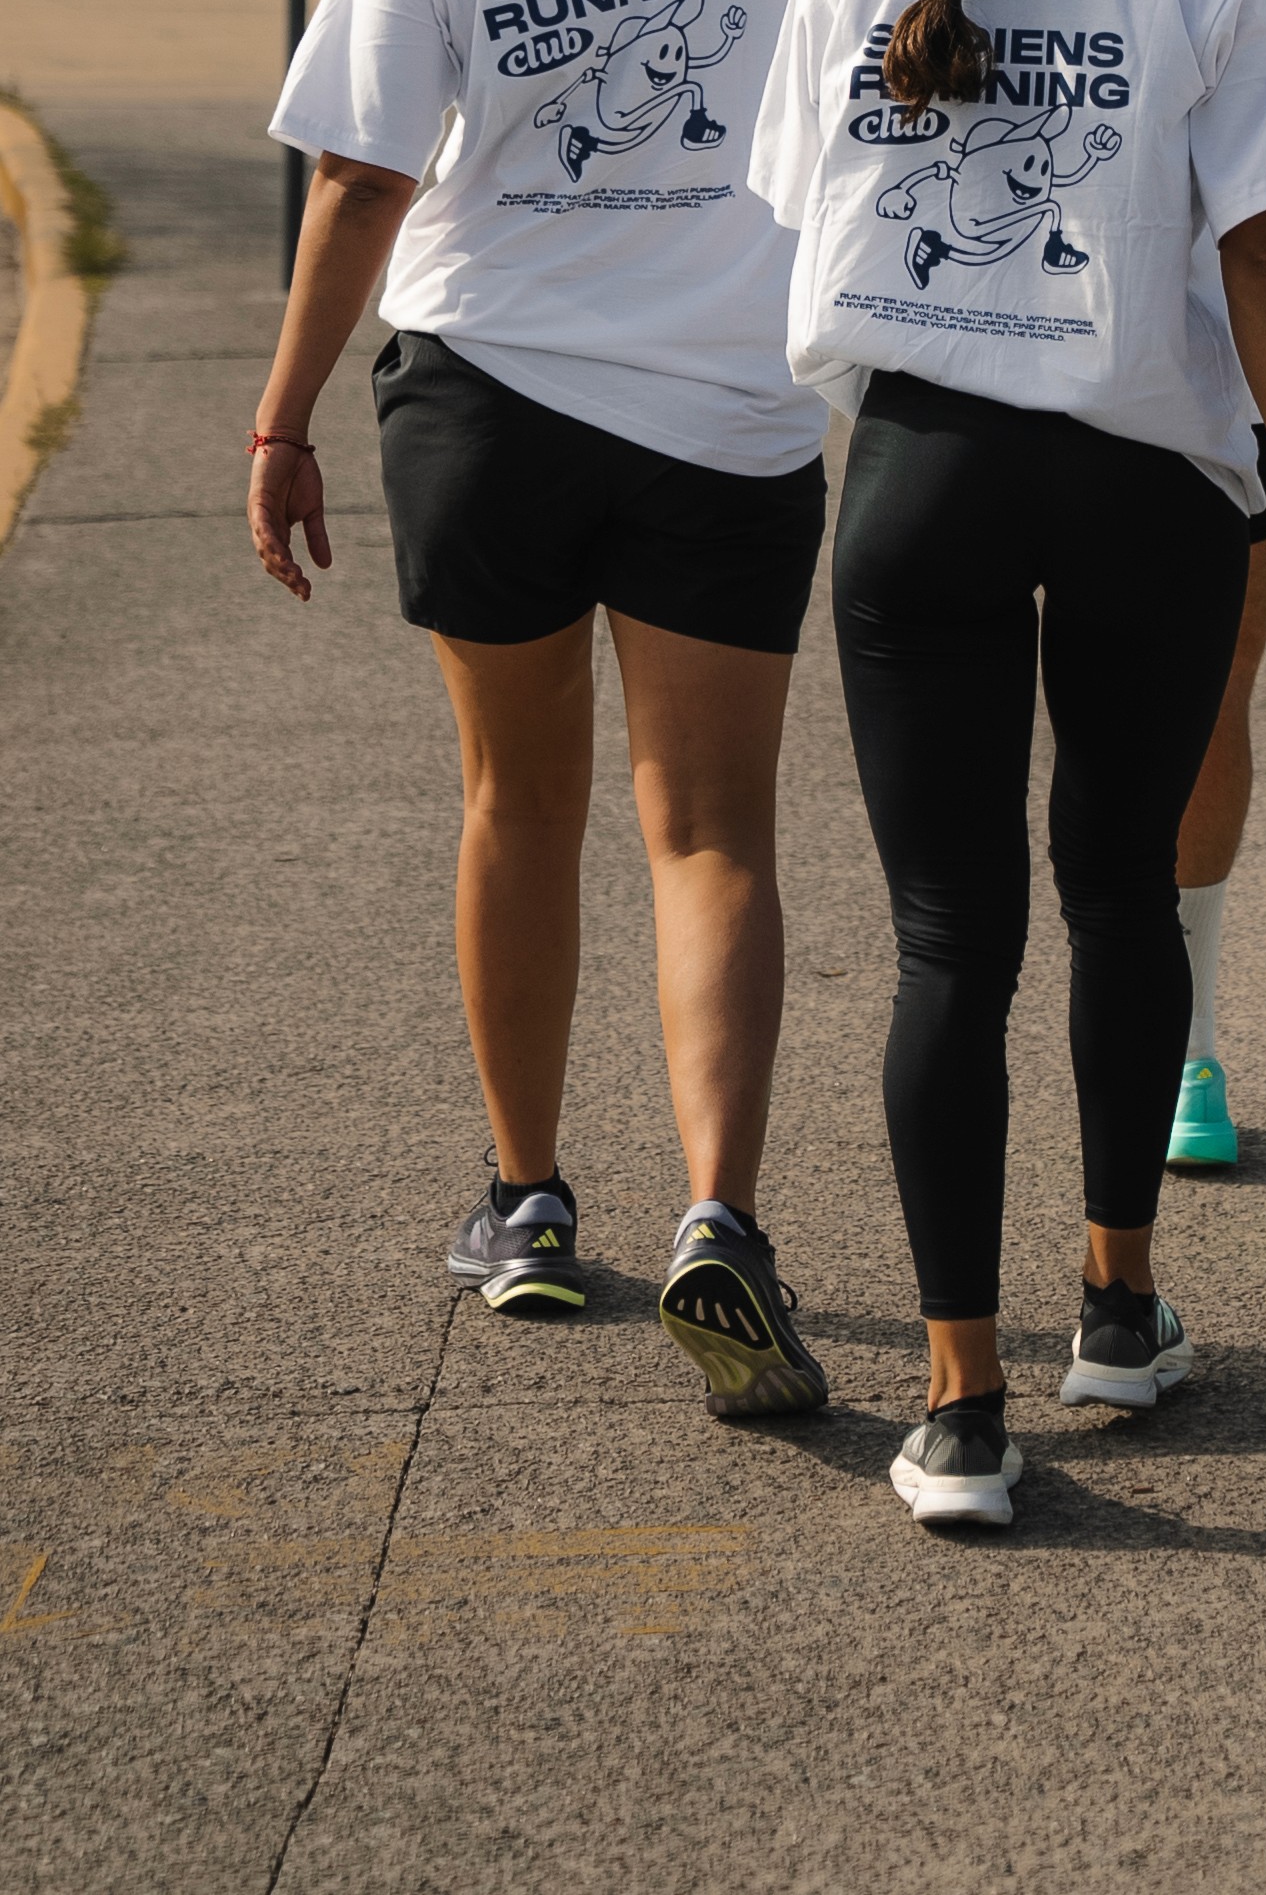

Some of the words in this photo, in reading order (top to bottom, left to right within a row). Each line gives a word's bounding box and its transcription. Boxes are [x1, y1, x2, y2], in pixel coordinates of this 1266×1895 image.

[506, 28, 583, 74] club
[863, 23, 1124, 67] SIENS
[849, 66, 1130, 109] RNING
[858, 107, 939, 142] club
[594, 195, 619, 203] PUSH
[610, 188, 636, 196] YOUR
[834, 300, 844, 308] IN
[846, 301, 879, 310] EVERY
[881, 305, 910, 317] STEP,
[913, 310, 946, 322] YOU'LL
[949, 316, 976, 325] PUSH
[1013, 323, 1036, 331] FIND
[840, 292, 861, 301] RUN
[863, 295, 897, 305] AFTER
[900, 300, 931, 311] WHAT
[932, 305, 963, 315] FUELS
[966, 309, 993, 318] YOUR
[1026, 315, 1051, 324] WITH
[1053, 318, 1093, 328] PURPOSE
[871, 312, 893, 321] AND
[895, 316, 927, 327] LEAVE
[929, 321, 957, 330] YOUR
[959, 326, 988, 335] MARK
[1007, 330, 1026, 338] THE
